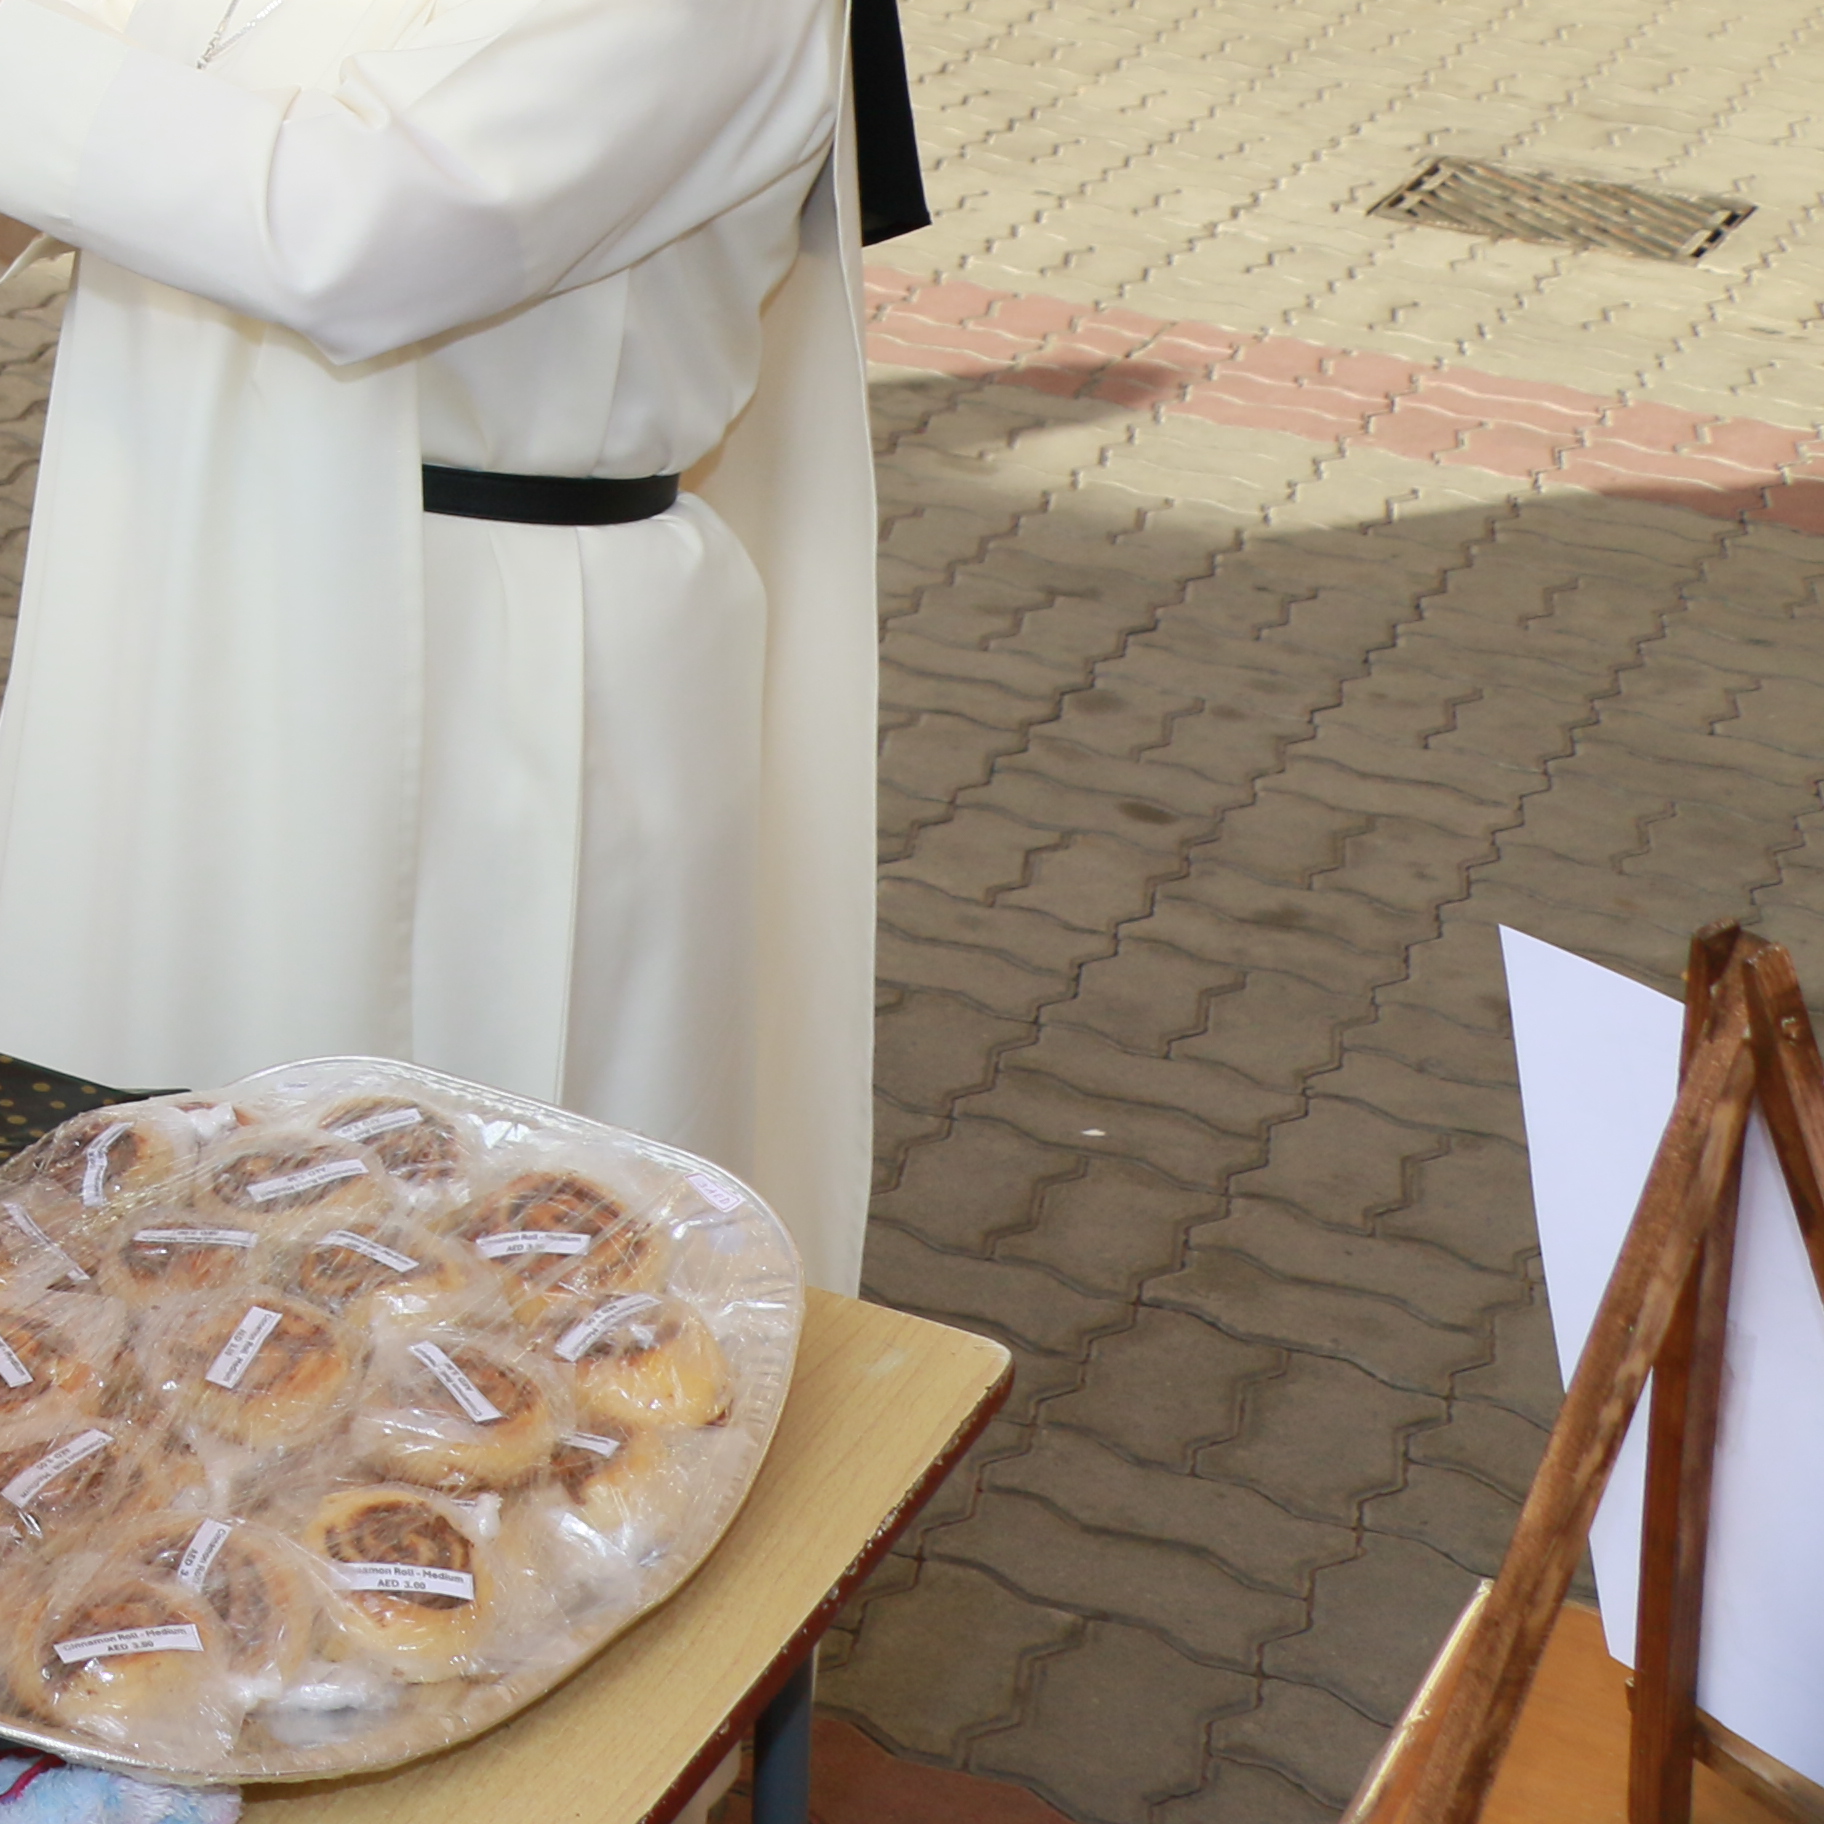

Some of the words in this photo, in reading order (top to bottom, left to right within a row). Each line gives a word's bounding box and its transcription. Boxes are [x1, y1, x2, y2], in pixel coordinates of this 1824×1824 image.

[394, 1567, 414, 1576] Roll
[422, 1569, 464, 1583] Medium
[377, 1579, 399, 1588] AED
[404, 1580, 426, 1589] 3.00
[63, 1635, 116, 1651] Cinnamon
[118, 1633, 137, 1641] Roll
[107, 1644, 128, 1652] AED
